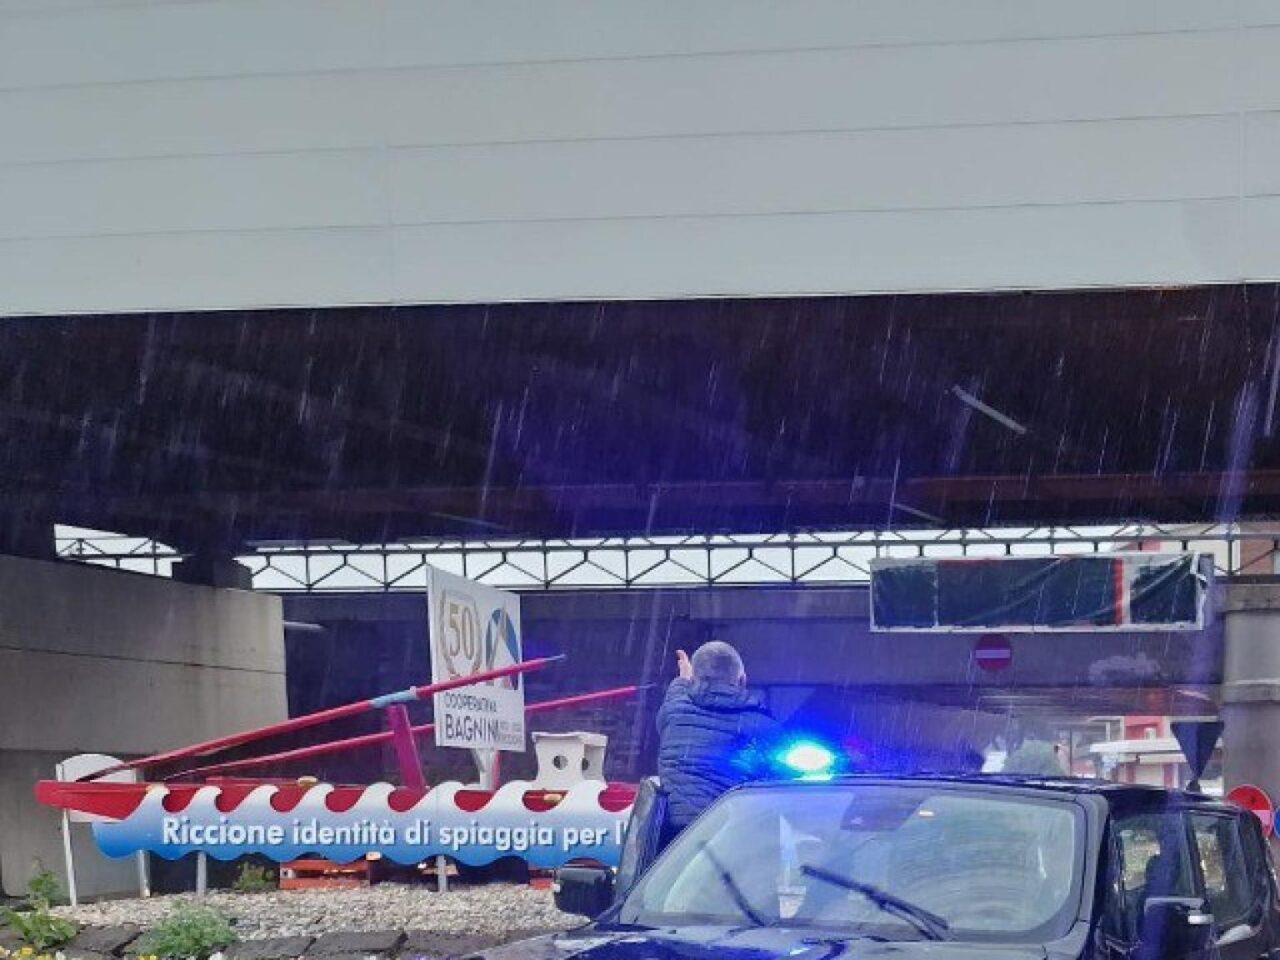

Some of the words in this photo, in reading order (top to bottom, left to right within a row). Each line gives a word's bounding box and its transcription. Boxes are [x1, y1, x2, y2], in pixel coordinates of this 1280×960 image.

[449, 603, 475, 661] 50
[445, 713, 499, 743] BAGNINI
[162, 816, 285, 845] Riccione
[293, 818, 395, 845] identità
[405, 819, 430, 845] di
[439, 820, 554, 851] spiaggia
[563, 826, 607, 850] per
